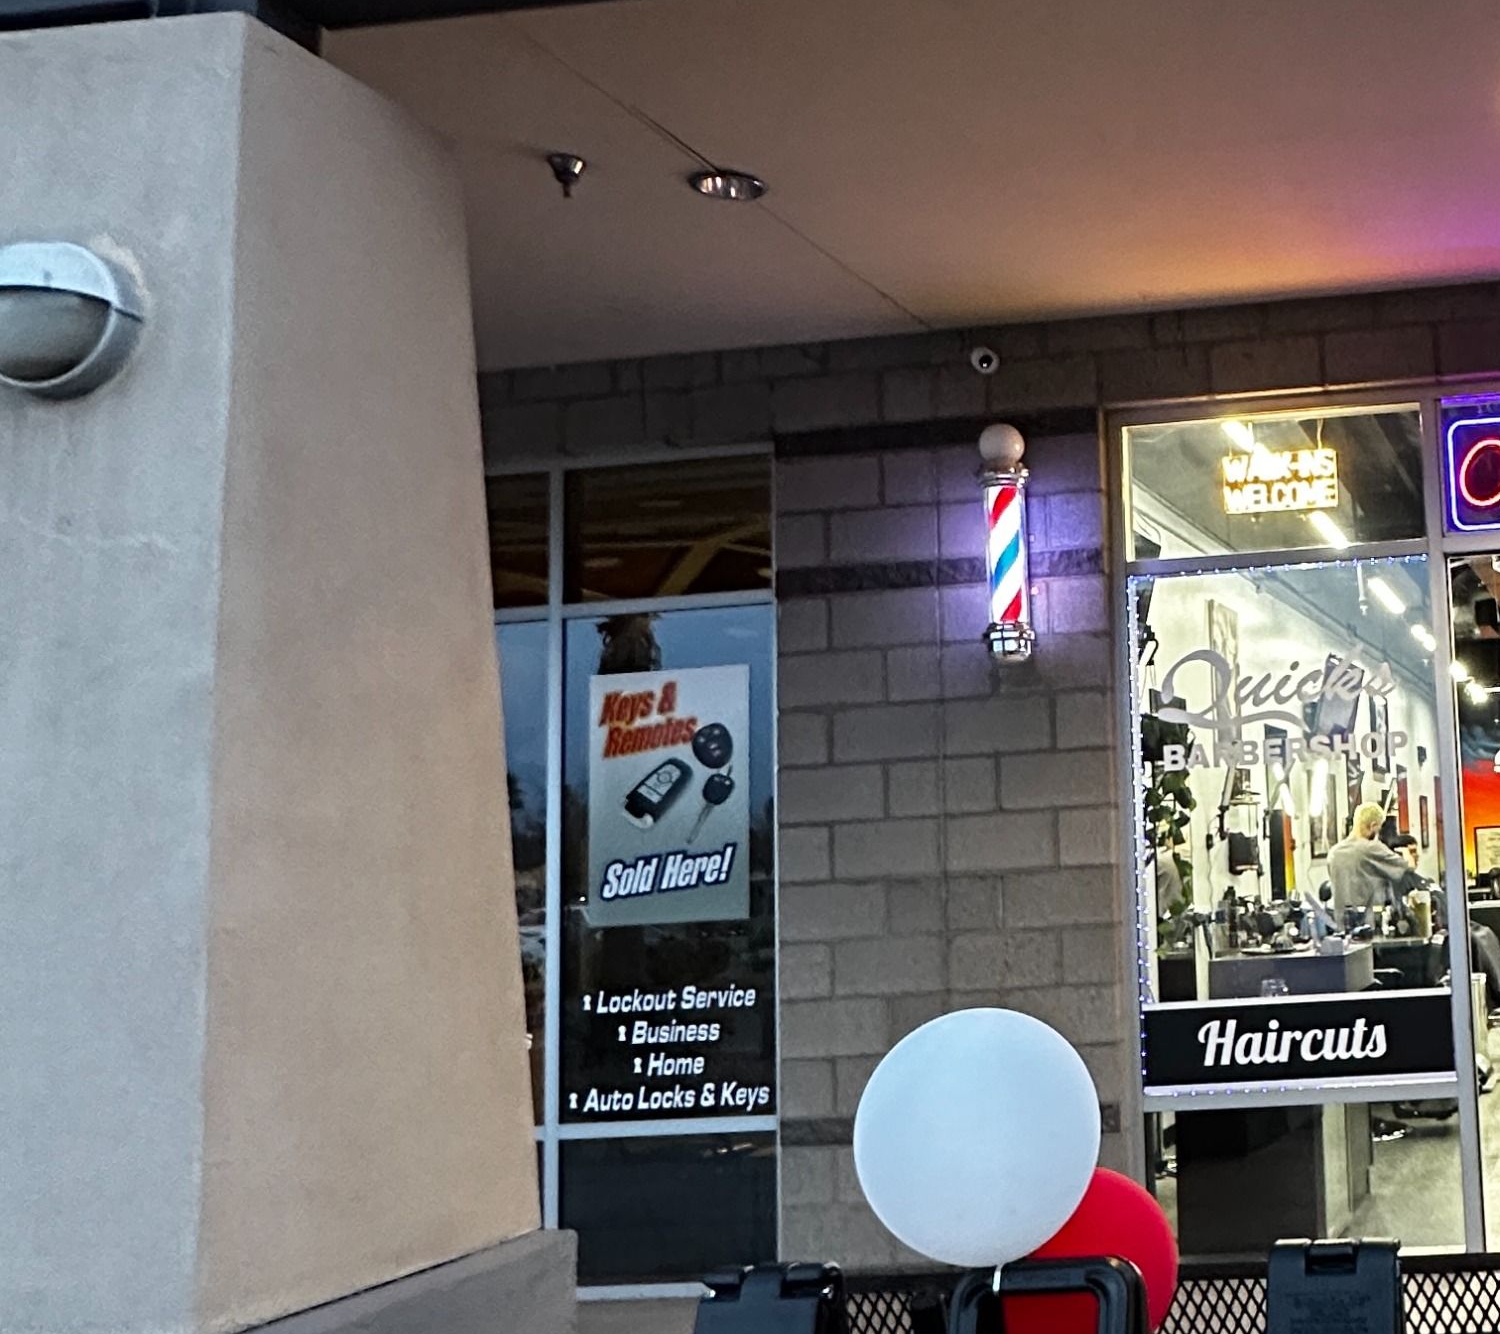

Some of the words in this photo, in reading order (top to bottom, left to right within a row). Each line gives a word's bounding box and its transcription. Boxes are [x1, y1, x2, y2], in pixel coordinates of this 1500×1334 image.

[1224, 478, 1338, 514] WELCOME
[1157, 642, 1397, 735] Quicks
[599, 690, 655, 727] Keys
[604, 717, 698, 759] Remotes
[1163, 730, 1409, 772] BARBERSHOP
[602, 855, 658, 900] Sold
[661, 846, 734, 891] Here!
[596, 989, 676, 1013] Lockout
[681, 984, 756, 1009] Service
[632, 1019, 721, 1044] Business
[1198, 1017, 1388, 1067] Haircuts
[647, 1053, 705, 1077] Home
[583, 1088, 634, 1113] Auto
[637, 1084, 696, 1109] Locks
[700, 1082, 716, 1107] &
[720, 1081, 770, 1111] Keys
